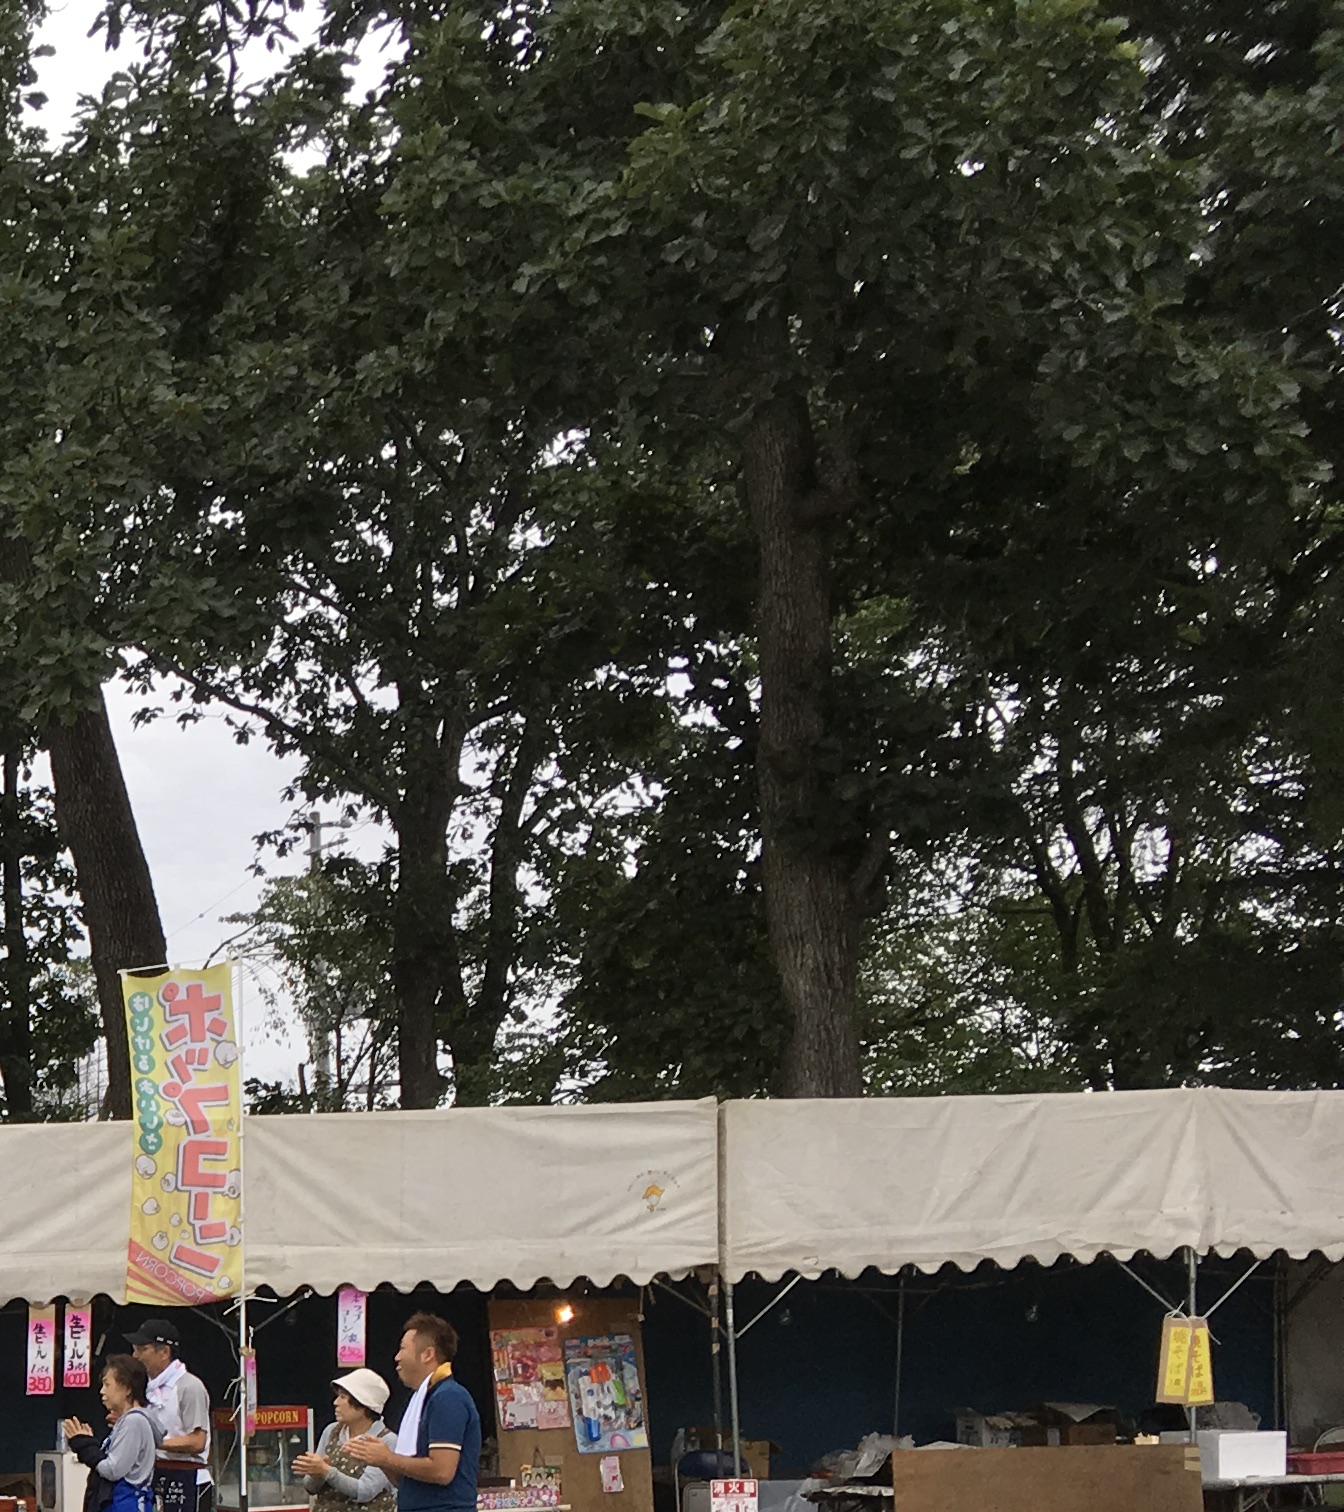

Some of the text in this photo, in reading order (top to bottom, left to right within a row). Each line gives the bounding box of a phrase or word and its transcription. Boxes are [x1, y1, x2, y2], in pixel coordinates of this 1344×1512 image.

[69, 1315, 86, 1359] 生ビール
[28, 1376, 52, 1392] 350
[64, 1372, 88, 1385] 1000
[255, 1408, 299, 1425] POPCORN
